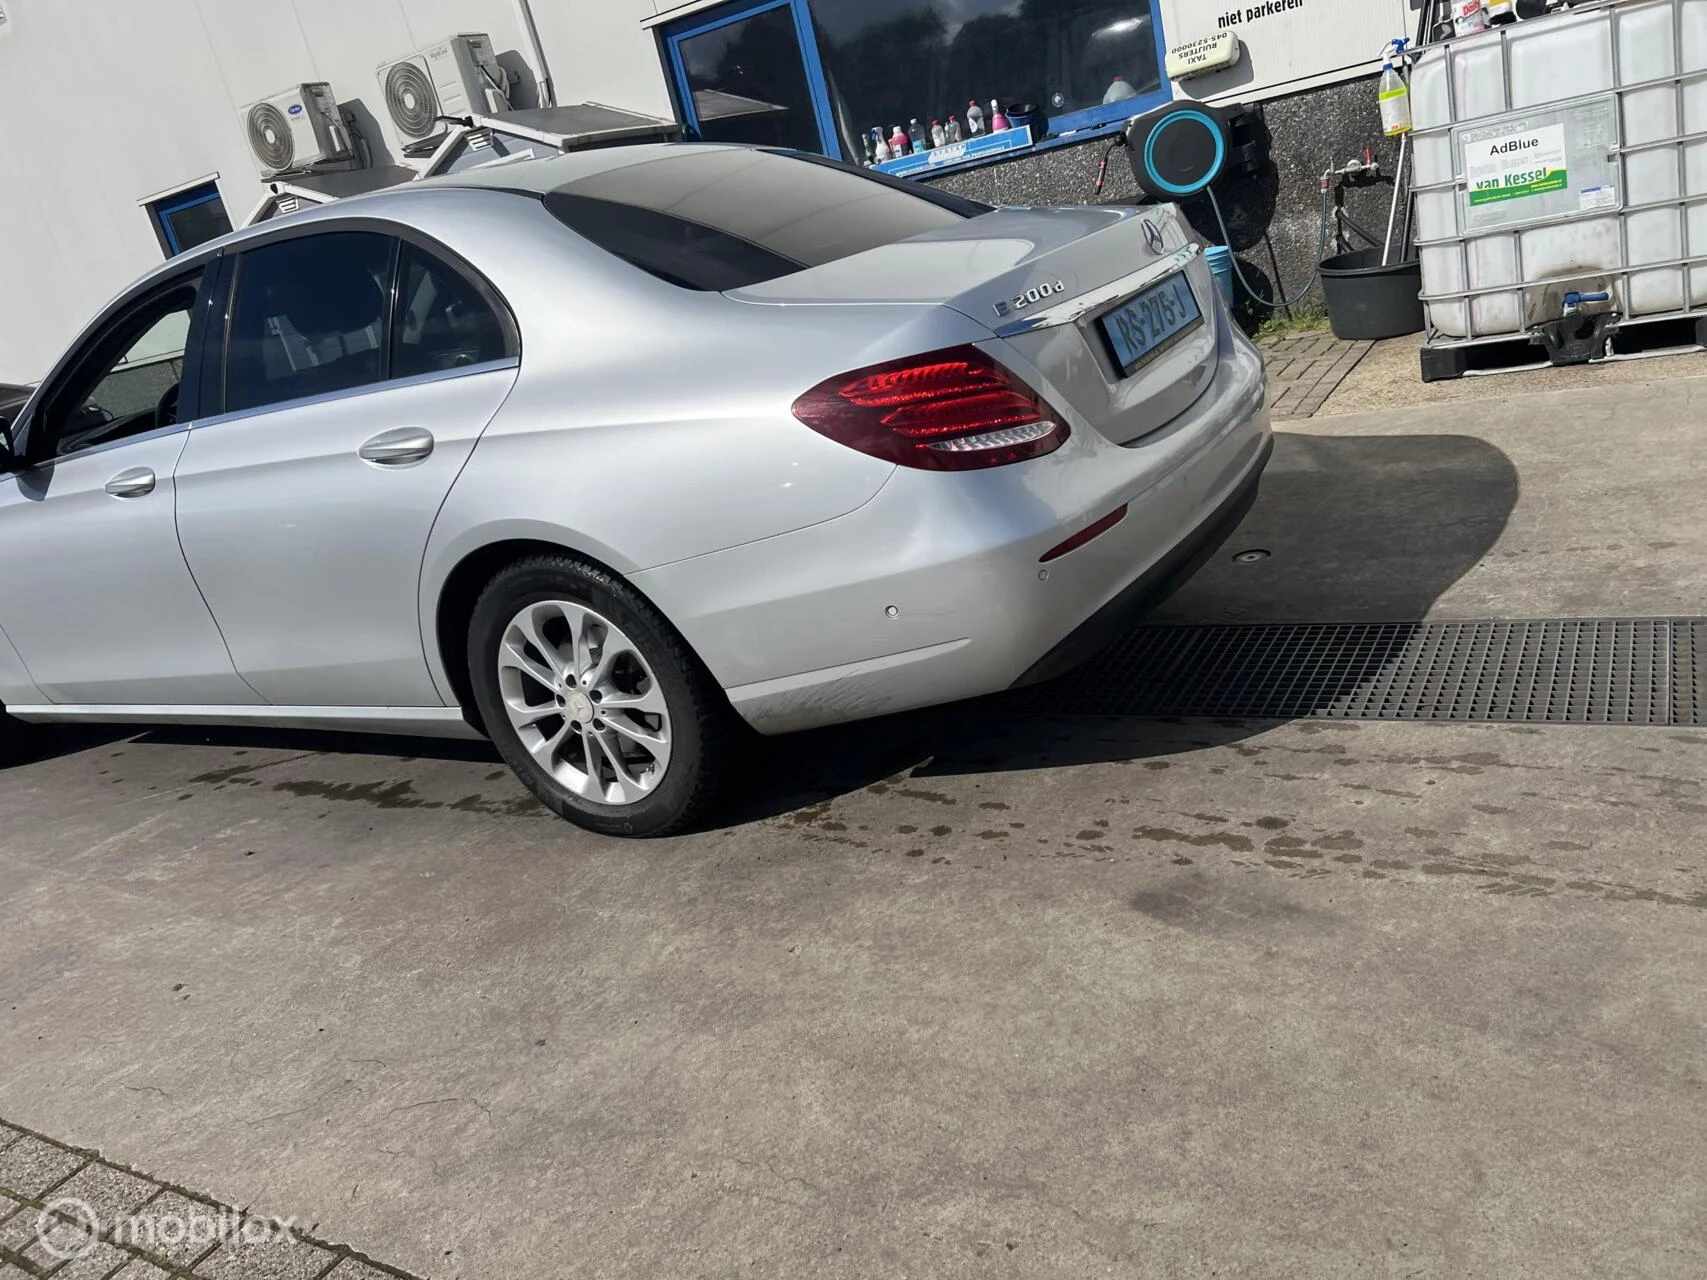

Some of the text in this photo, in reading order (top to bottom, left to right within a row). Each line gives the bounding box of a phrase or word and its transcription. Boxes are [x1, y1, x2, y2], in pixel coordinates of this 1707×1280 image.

[1218, 0, 1303, 28] niet parkeren
[1178, 42, 1218, 60] RUIJTERS
[1187, 54, 1208, 65] TAXI
[1489, 137, 1539, 156] AdBlue
[1476, 176, 1500, 190] van
[1504, 167, 1547, 187] Kessel
